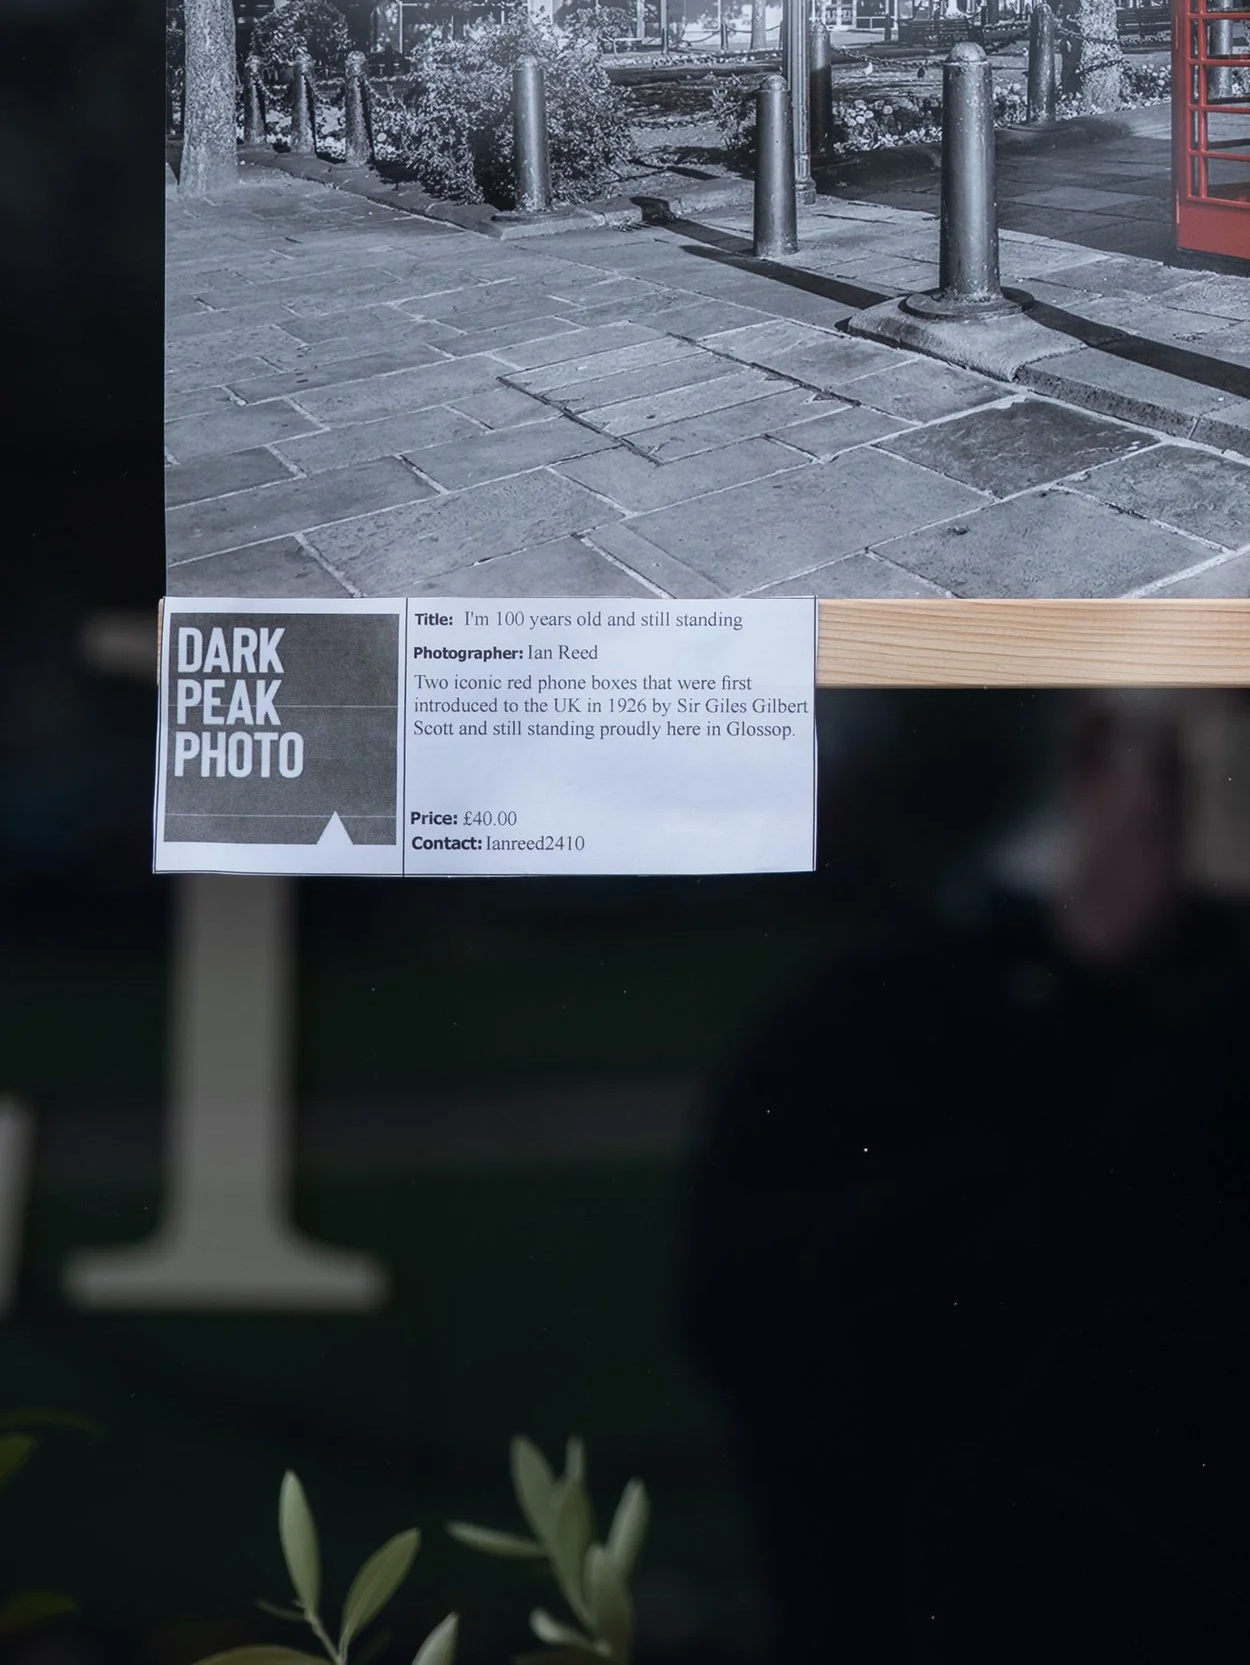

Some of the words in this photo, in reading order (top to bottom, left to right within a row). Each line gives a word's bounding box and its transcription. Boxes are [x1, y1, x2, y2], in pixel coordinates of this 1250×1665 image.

[413, 612, 454, 627] Title:
[464, 610, 489, 626] I'm
[497, 610, 525, 627] 100
[529, 615, 572, 631] years
[576, 610, 602, 627] old
[607, 610, 636, 627] and
[640, 610, 671, 627] still
[675, 611, 744, 631] standing
[177, 627, 285, 674] DARK
[413, 645, 524, 663] Photographer:
[527, 644, 553, 660] Ian
[557, 644, 598, 660] Reed
[413, 674, 449, 690] Two
[454, 673, 503, 690] iconic
[507, 674, 533, 690] red
[537, 674, 587, 694] phone
[591, 674, 638, 691] boxes
[642, 674, 673, 691] that
[676, 679, 717, 691] were
[721, 674, 753, 691] first
[176, 678, 282, 726] PEAK
[414, 696, 499, 713] introduced
[503, 699, 519, 713] to
[523, 697, 549, 713] the
[553, 697, 582, 713] UK
[587, 697, 603, 713] in
[609, 697, 647, 714] 1926
[652, 697, 672, 718] by
[677, 697, 701, 714] Sir
[704, 697, 748, 714] Giles
[751, 697, 809, 714] Gilbert
[413, 719, 455, 736] Scott
[458, 719, 488, 736] and
[492, 719, 522, 736] still
[527, 720, 596, 741] standing
[599, 720, 662, 741] proudly
[666, 720, 702, 737] here
[706, 720, 722, 737] in
[726, 720, 796, 741] Glossop.
[174, 731, 304, 779] PHOTO
[410, 810, 458, 826] Price:
[462, 810, 518, 827] £40.00
[411, 835, 483, 851] Contact:
[486, 835, 586, 852] Ianreed2410
